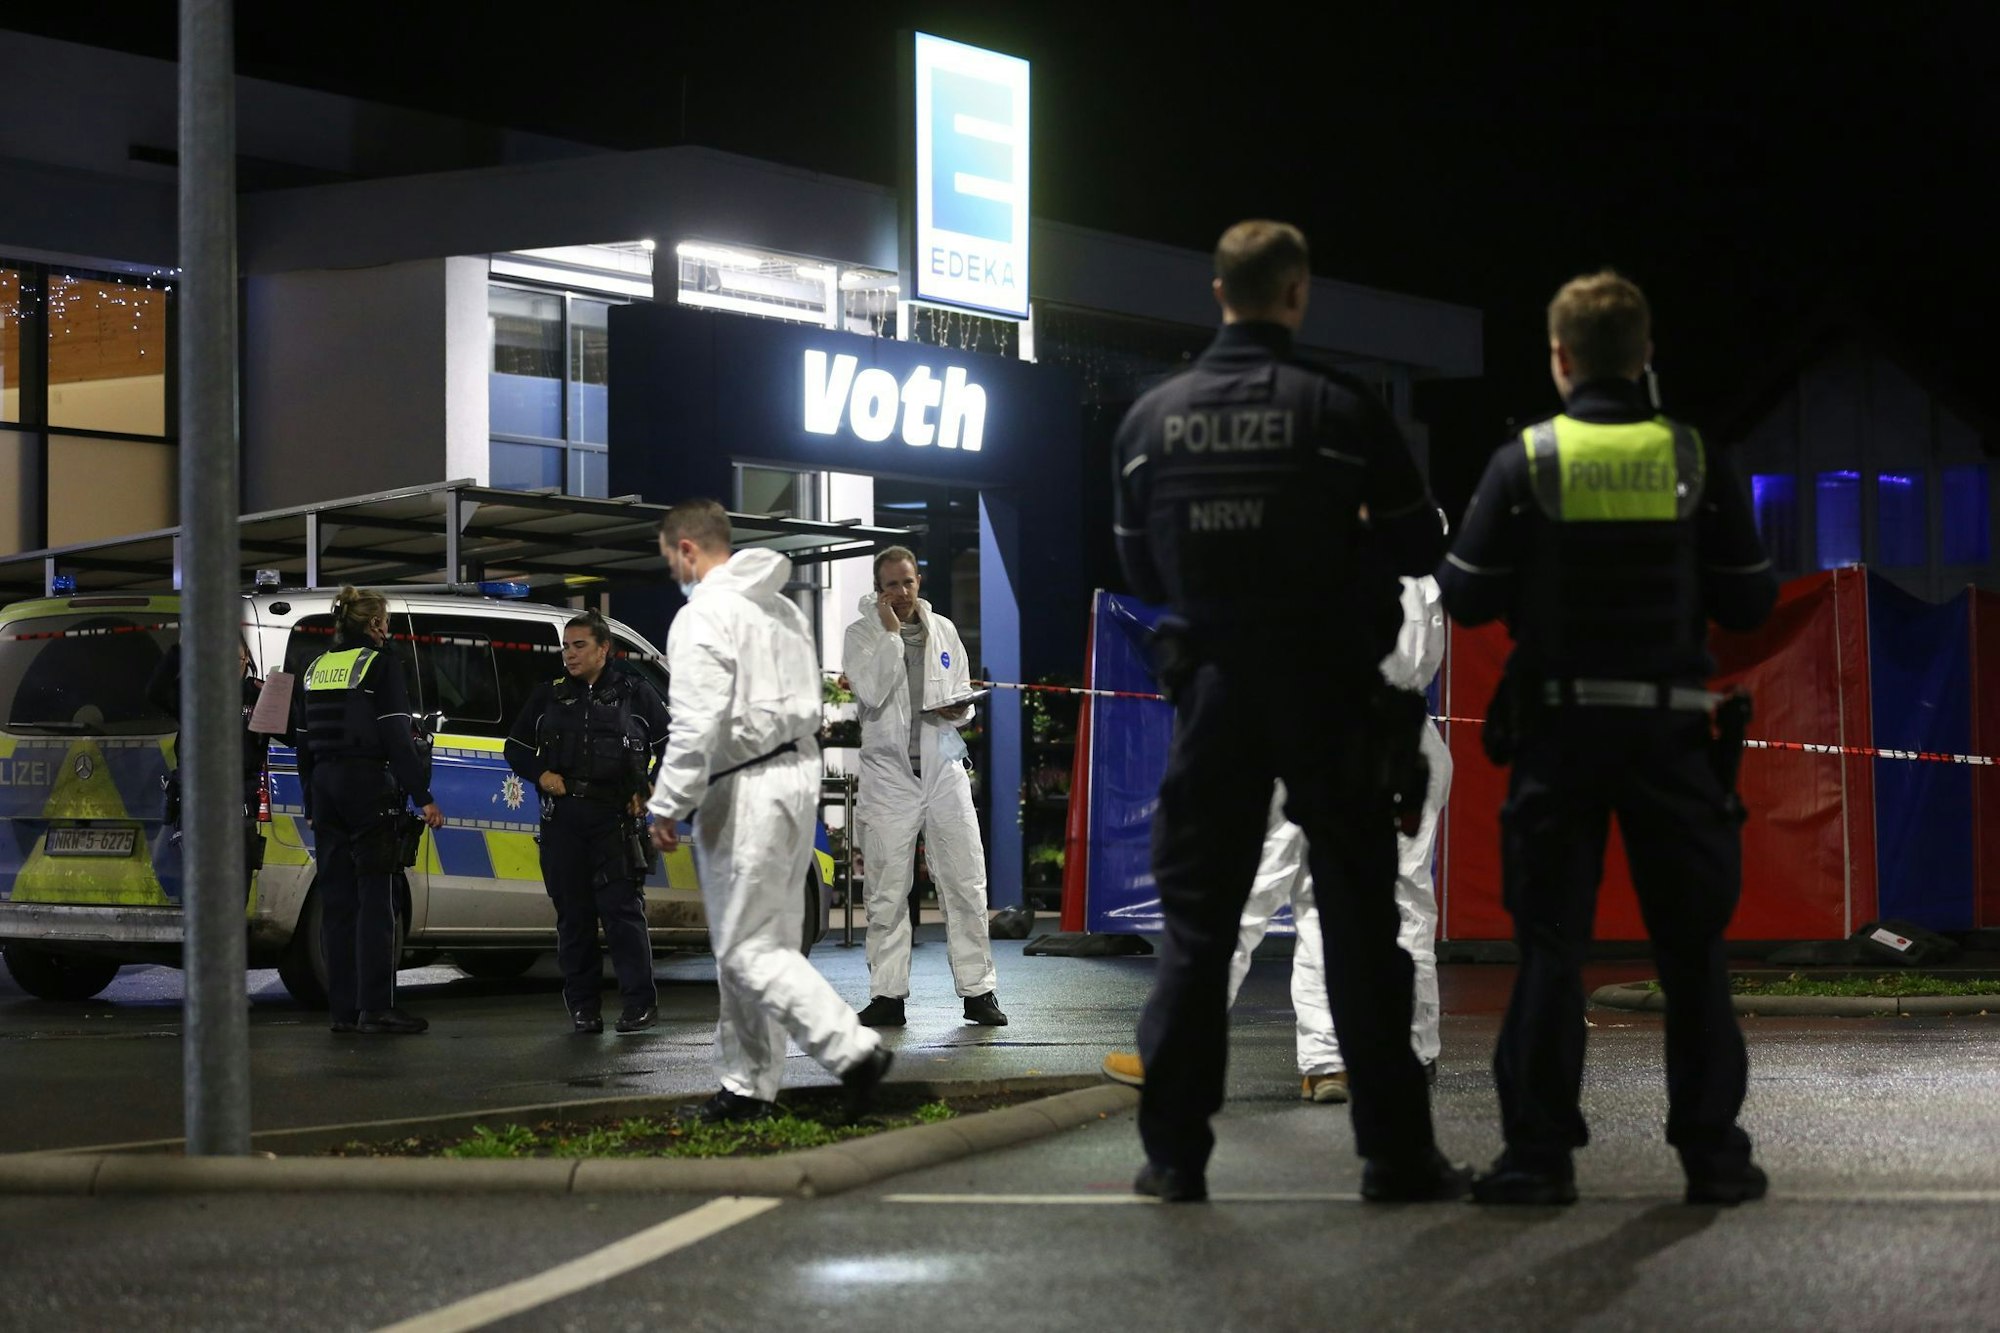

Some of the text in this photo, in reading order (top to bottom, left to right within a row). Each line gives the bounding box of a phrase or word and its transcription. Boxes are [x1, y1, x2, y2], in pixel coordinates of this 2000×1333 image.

[931, 66, 1013, 243] E
[931, 247, 1015, 288] EDEKA
[804, 349, 986, 452] Voth
[1163, 411, 1294, 454] POLIZEI
[1569, 460, 1669, 492] POLIZEI
[1189, 499, 1263, 531] NRW
[313, 668, 349, 684] POLIZEI
